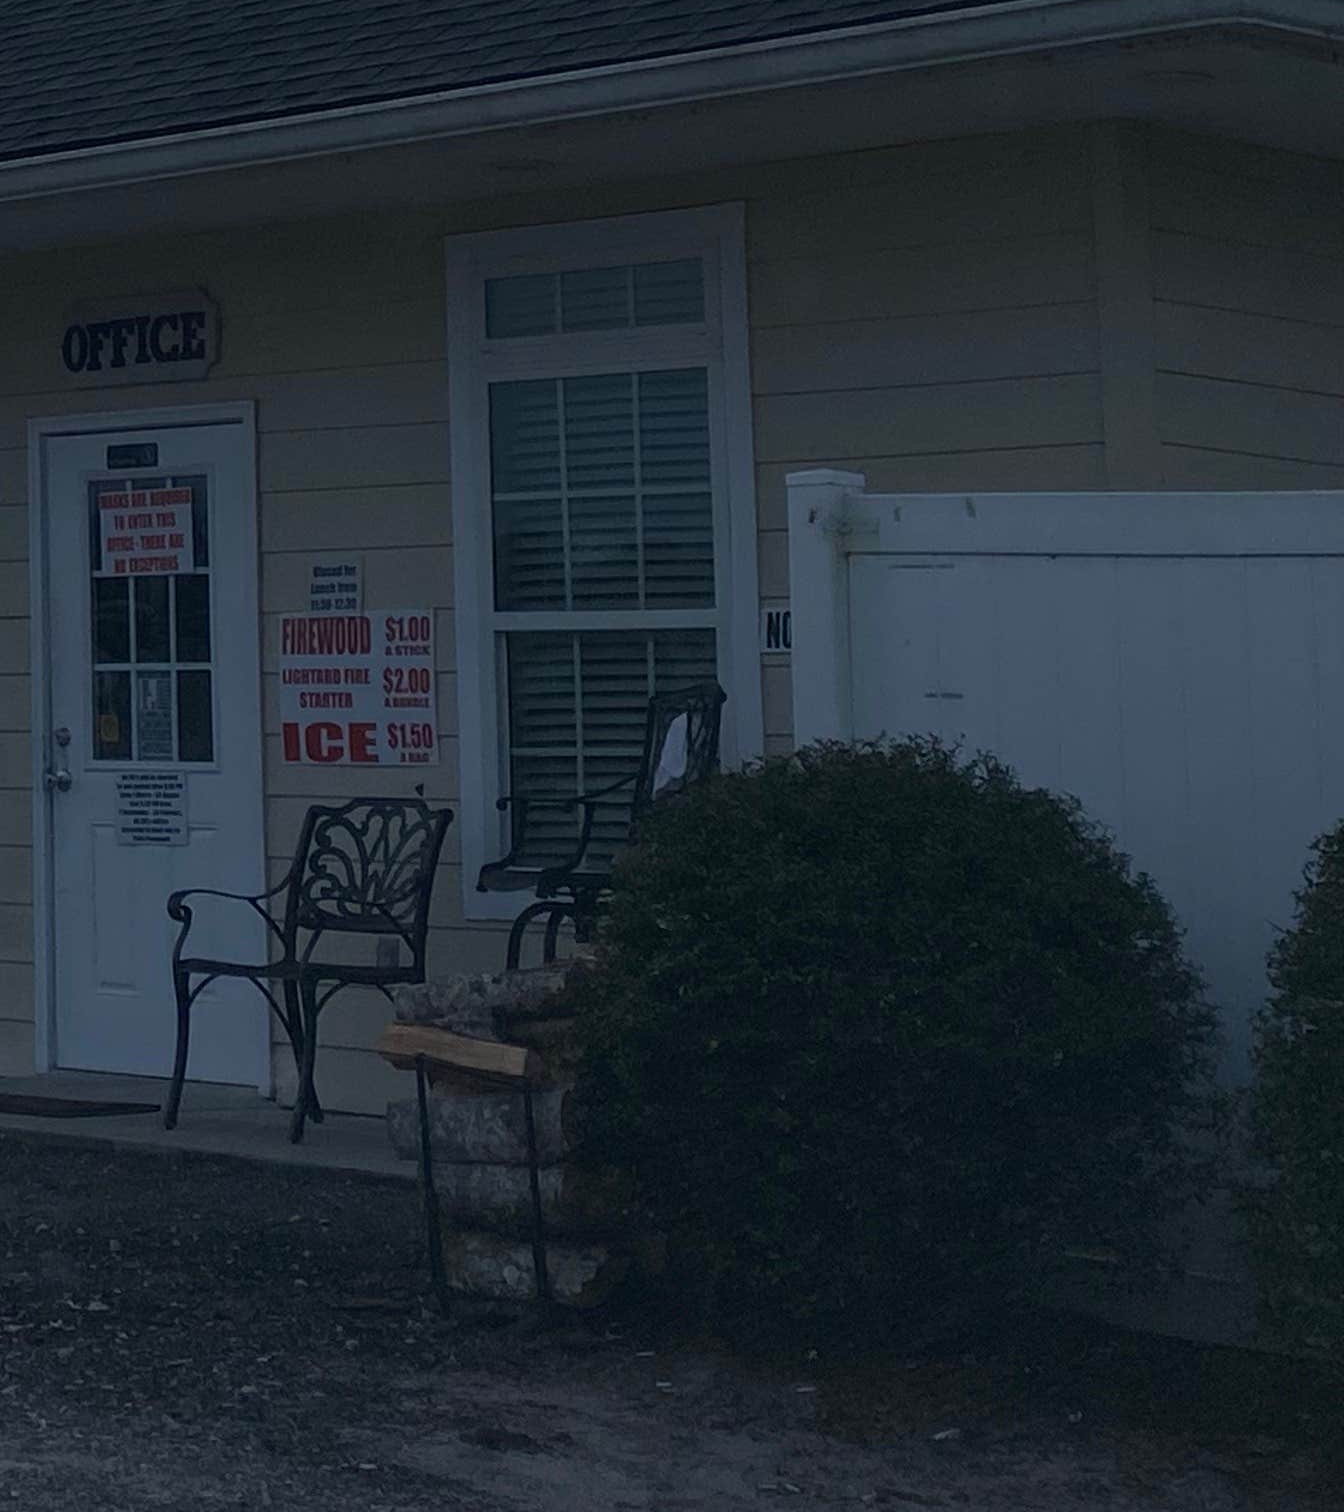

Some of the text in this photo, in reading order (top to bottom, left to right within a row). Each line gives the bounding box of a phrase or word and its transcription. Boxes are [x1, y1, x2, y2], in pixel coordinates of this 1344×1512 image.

[62, 312, 206, 372] OFFICE
[114, 512, 177, 530] TO ENTER THIS
[282, 615, 431, 656] FIREWOOD $1.00
[395, 645, 431, 657] STICK
[344, 668, 371, 685] FIRE
[383, 667, 431, 694] $2.00
[299, 691, 353, 709] STARTER
[282, 722, 434, 763] ICE $1.50
